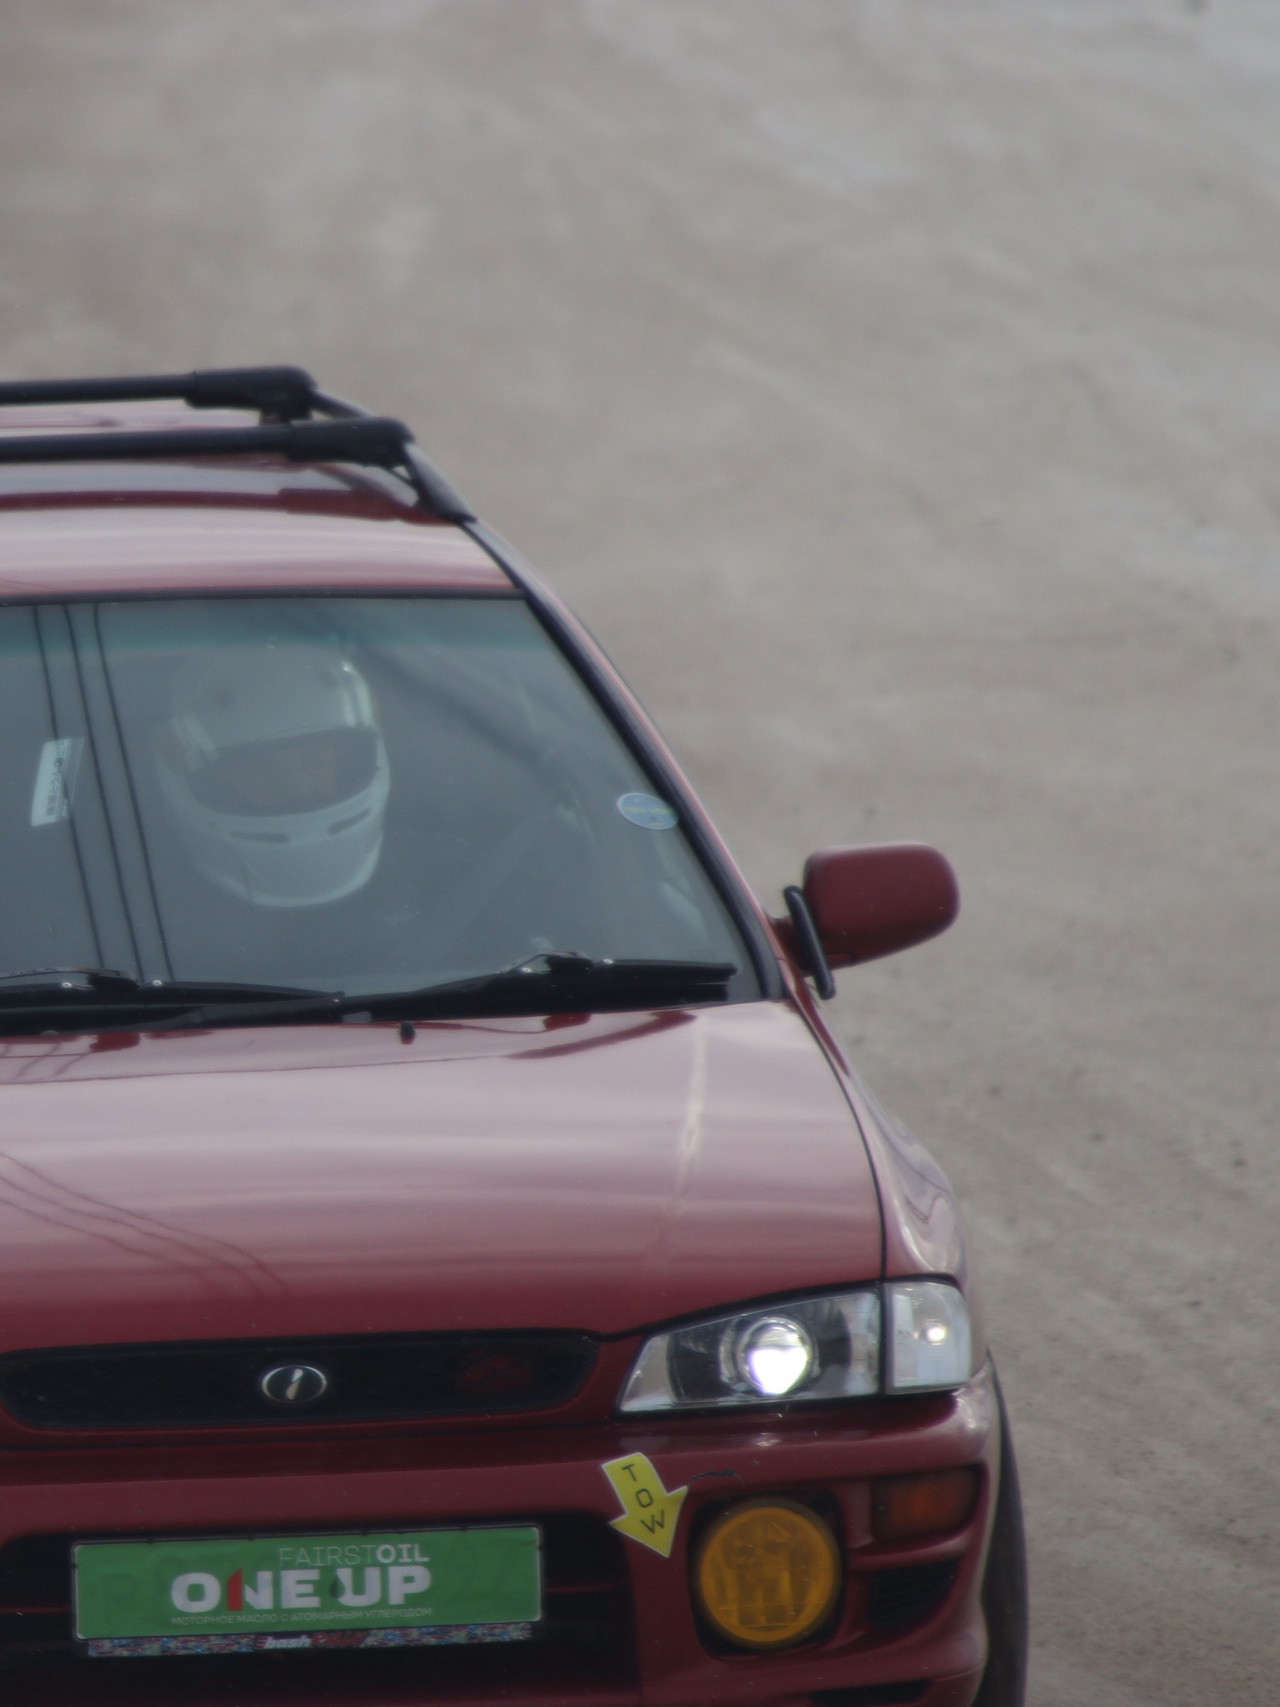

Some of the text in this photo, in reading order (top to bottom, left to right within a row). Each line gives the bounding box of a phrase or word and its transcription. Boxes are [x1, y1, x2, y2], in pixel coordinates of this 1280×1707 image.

[621, 1463, 665, 1534] TOW
[278, 1543, 431, 1567] FAIRSTOIL
[170, 1565, 432, 1613] ONE UP
[170, 1614, 235, 1626] МОТОРНОЕ
[236, 1613, 278, 1624] МАСЛО
[290, 1610, 363, 1622] АТОМАРНЫМ
[363, 1607, 433, 1619] УГЛЕРОДОМ
